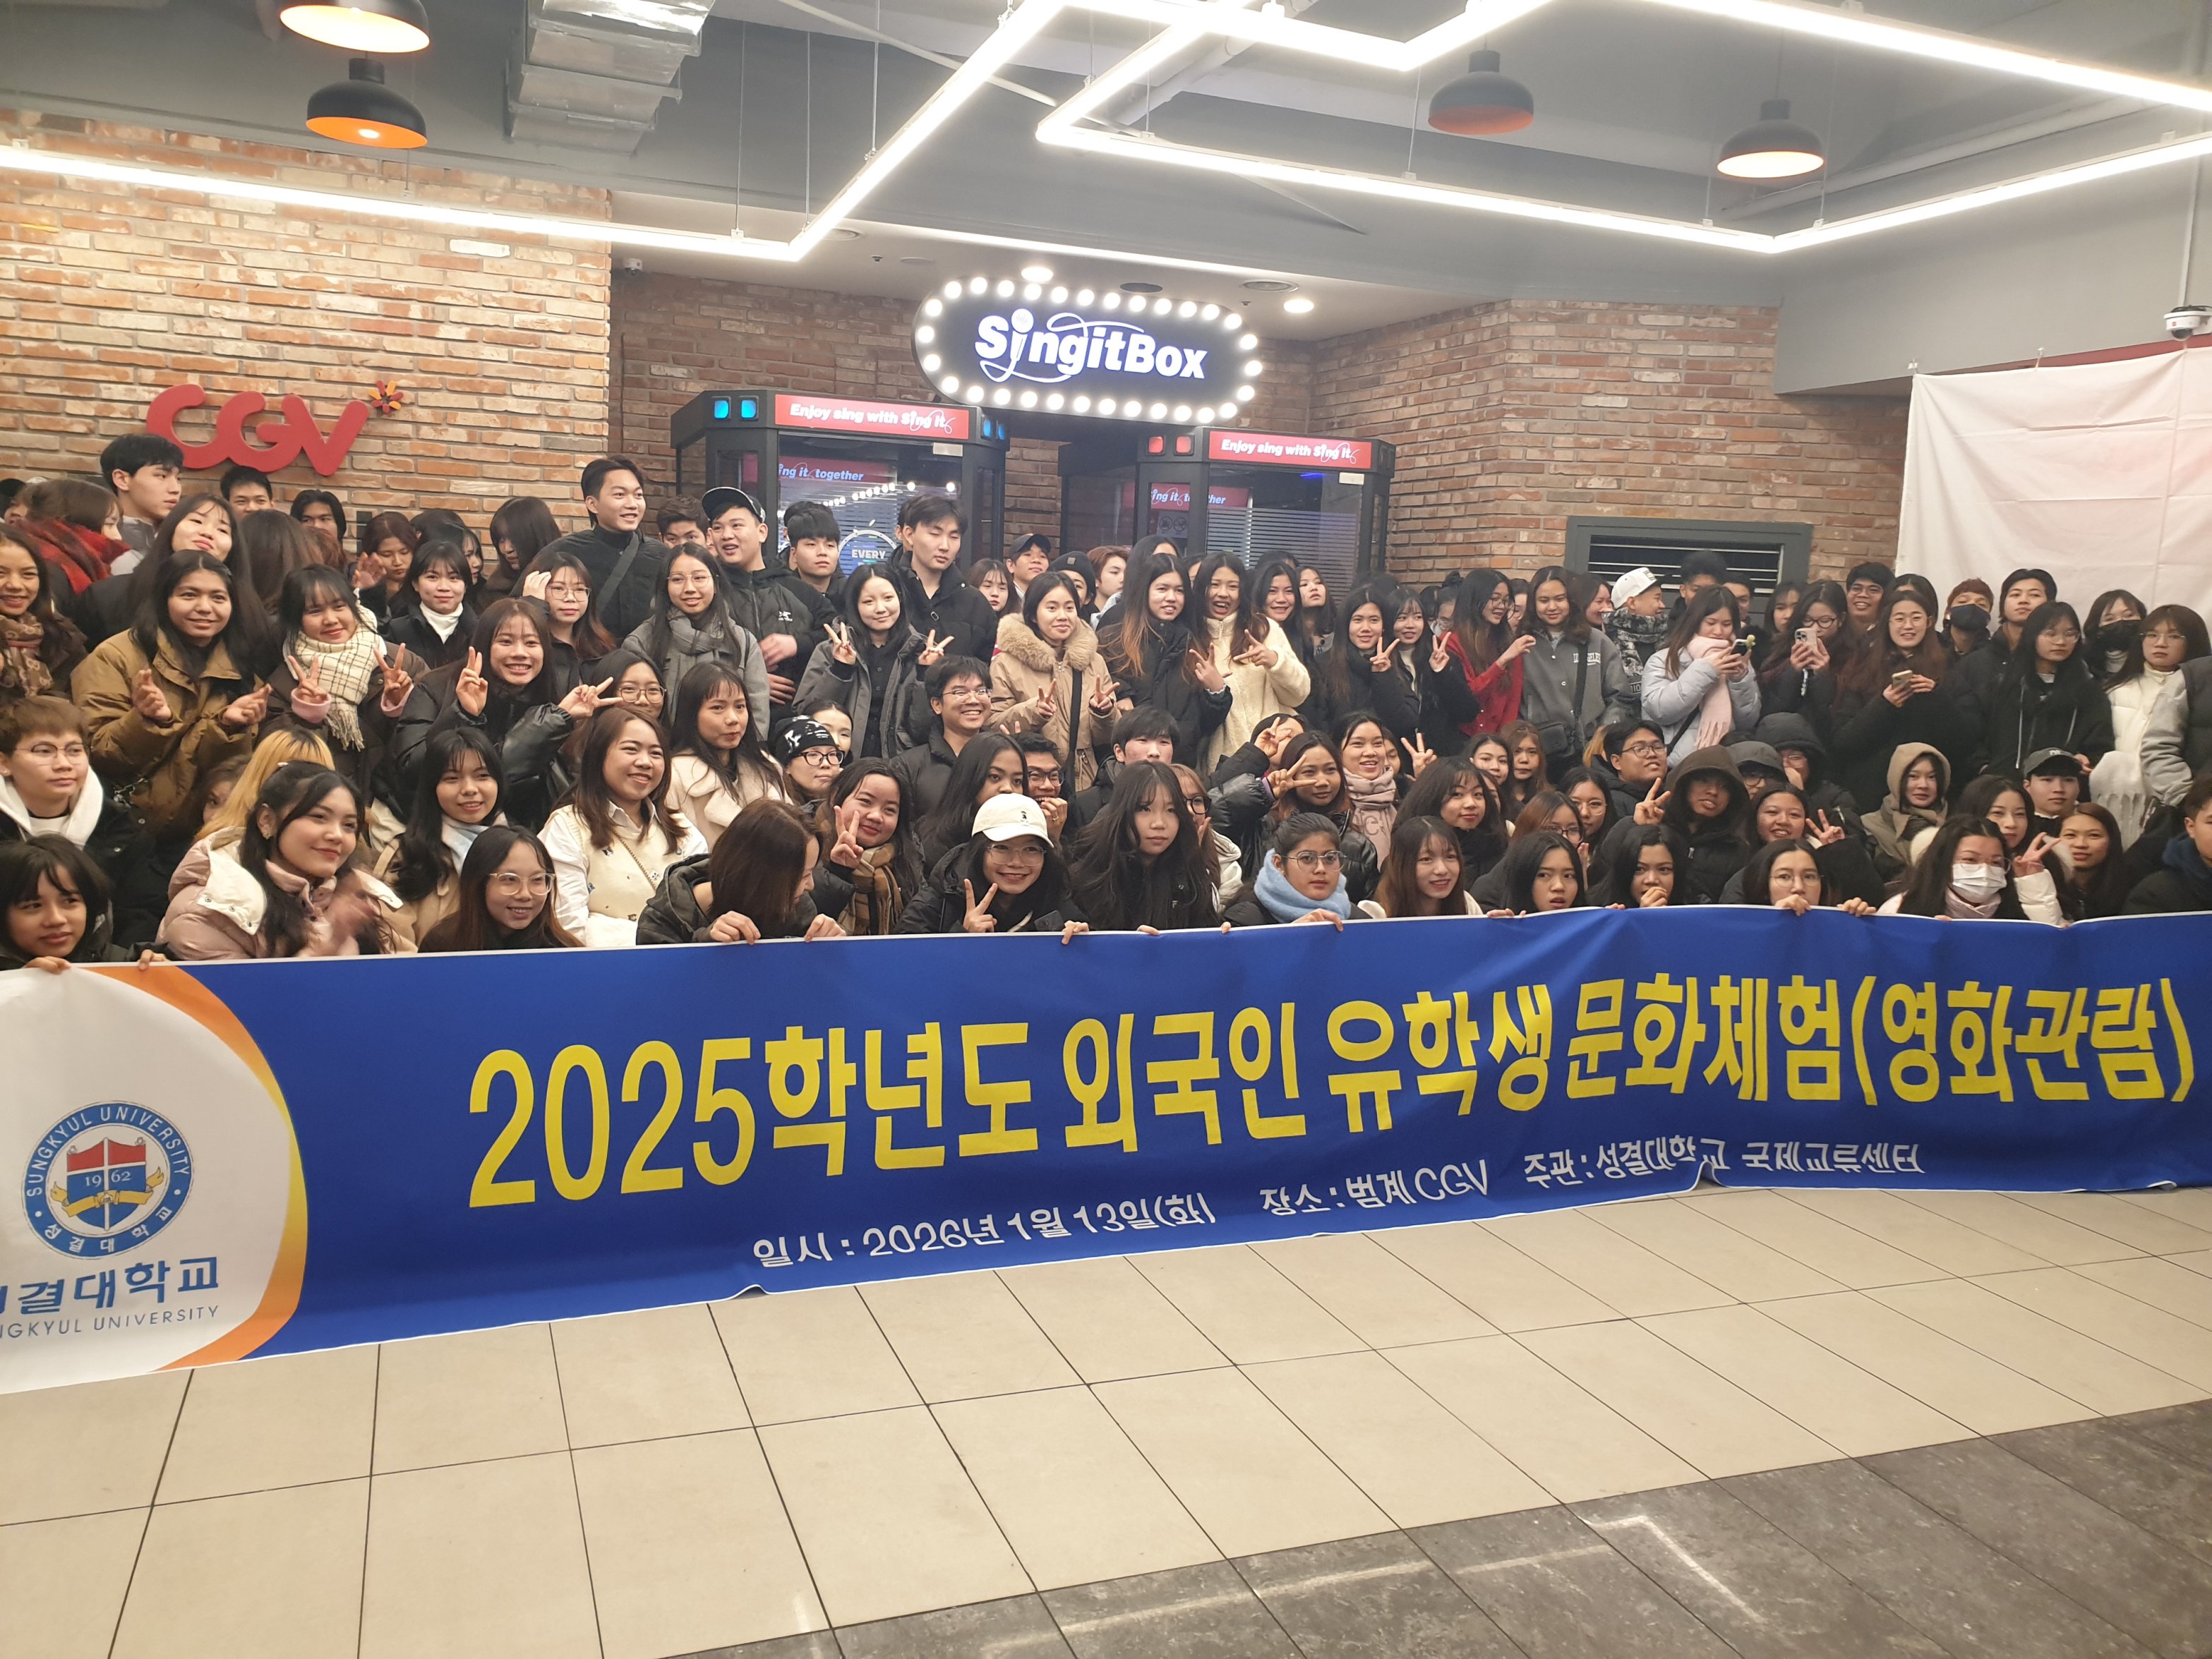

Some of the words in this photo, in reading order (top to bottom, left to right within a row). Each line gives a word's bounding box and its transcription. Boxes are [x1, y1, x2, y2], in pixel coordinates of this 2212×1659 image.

[975, 308, 1208, 383] SingitBox
[146, 384, 370, 476] CGV
[790, 403, 831, 421] Enjoy
[833, 407, 864, 423] sing
[867, 410, 898, 425] with
[901, 411, 932, 430] Sing
[934, 414, 946, 428] it
[1221, 439, 1256, 454] Enjoy
[1257, 442, 1283, 457] sing
[1285, 444, 1311, 457] with
[1313, 444, 1340, 461] Sing
[1341, 447, 1352, 459] it
[778, 464, 797, 478] ing
[799, 467, 810, 478] it
[815, 469, 864, 482] together
[1150, 489, 1169, 503] ing
[1170, 492, 1179, 502] it
[851, 549, 886, 560] EVERY
[469, 1022, 1039, 1207] 2025학년도
[1062, 1002, 1306, 1152] 외국인
[1327, 984, 1553, 1134] 유학생
[1566, 972, 2194, 1106] 문화체험(영화관람)
[26, 1112, 93, 1197] SUNGKYUL
[100, 1106, 190, 1175] UNIVERSITY
[1741, 1141, 1926, 1174] 국제교류센터
[44, 1205, 173, 1254] 성결대학교
[862, 1214, 1006, 1257] 2026년
[1007, 1207, 1073, 1241] 1월
[1073, 1192, 1216, 1233] 13일(화)
[0, 1319, 82, 1339] GKYUL
[93, 1305, 219, 1331] UNIVERSITY
